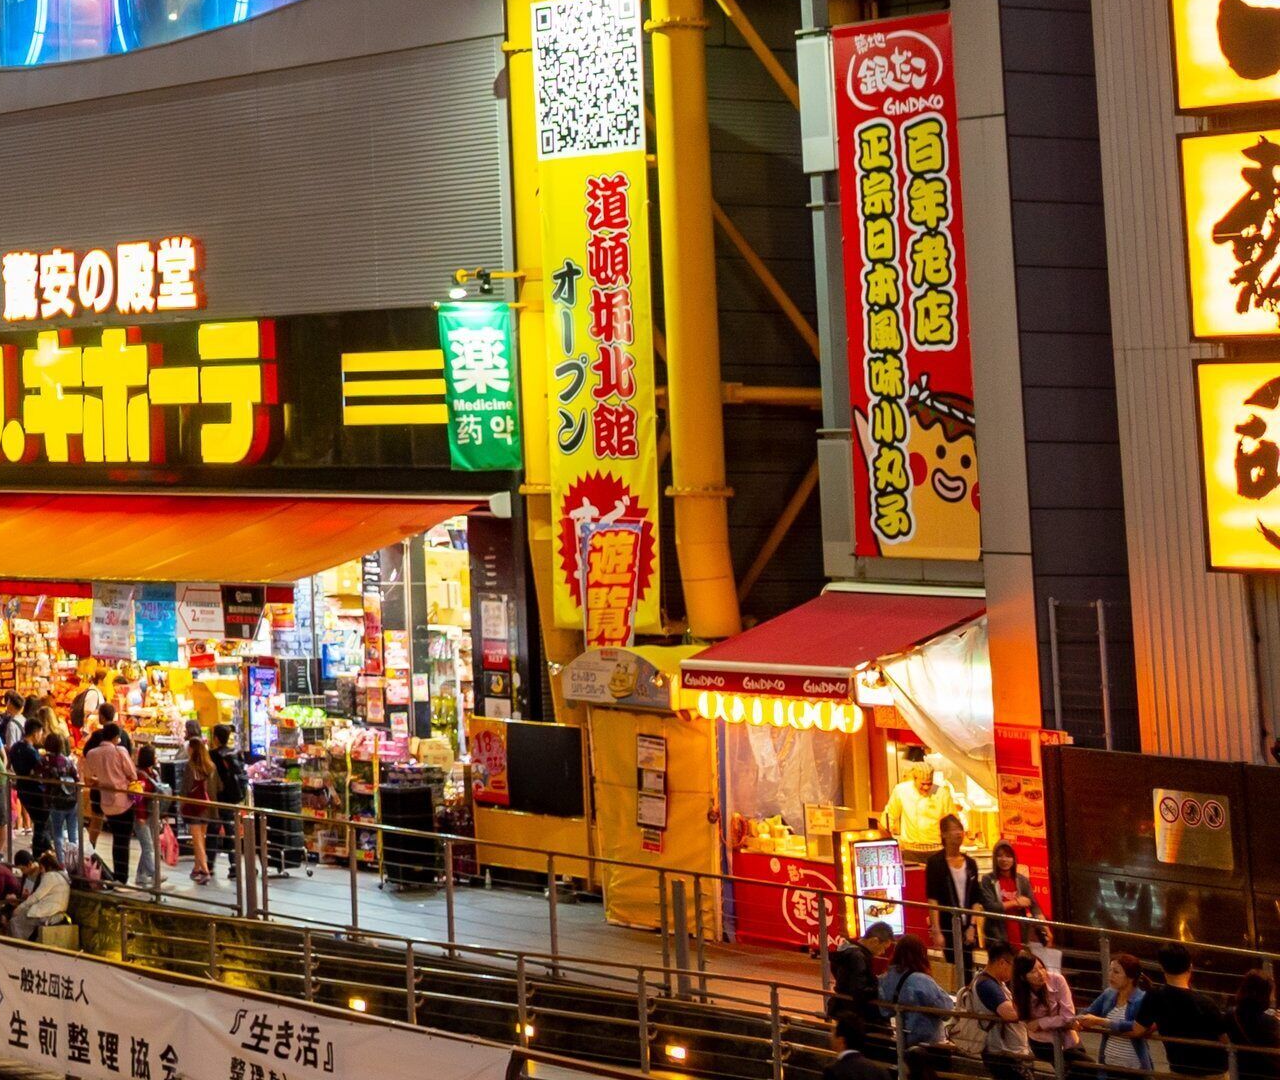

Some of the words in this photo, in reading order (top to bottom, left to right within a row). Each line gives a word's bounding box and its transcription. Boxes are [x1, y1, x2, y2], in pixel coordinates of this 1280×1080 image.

[857, 48, 928, 97] 銀だこ
[882, 94, 944, 116] GINDACO
[905, 121, 955, 348] 百年老店
[2, 236, 200, 321] 驚安の殿堂
[584, 172, 639, 461] 道頓堀北館
[857, 123, 912, 540] 正宗日本風味小丸子
[449, 327, 509, 394] 薬
[551, 260, 587, 457] オープン
[453, 398, 513, 413] Medicine
[588, 532, 636, 647] 遊覧
[684, 673, 725, 687] GINDACO
[743, 676, 785, 691] GINDACO
[803, 679, 846, 694] GINDACO
[8, 969, 90, 1006] 一般社団法人
[8, 1010, 181, 1080] 生前整理協会
[229, 1009, 334, 1074] 『生き活』
